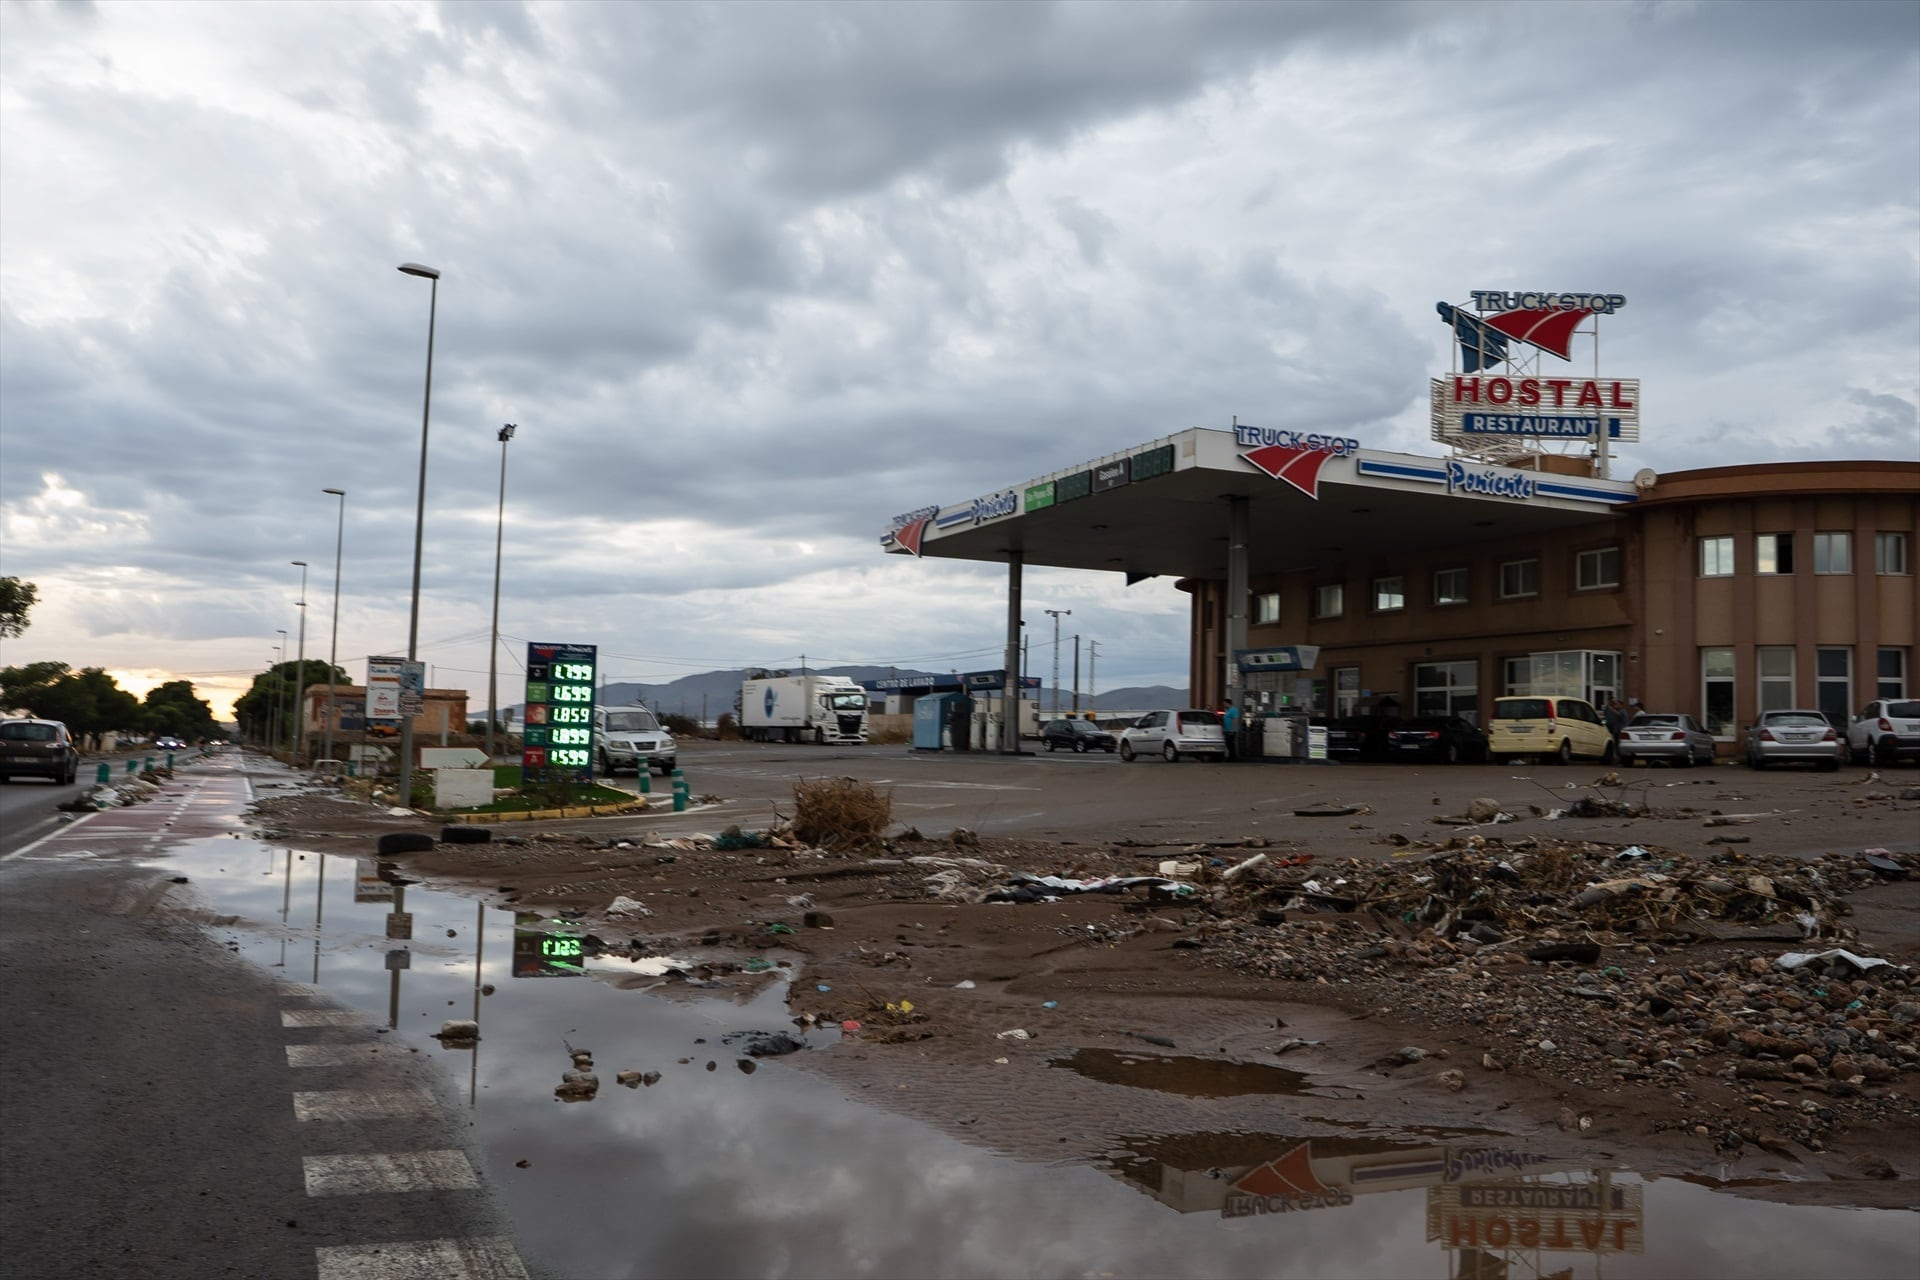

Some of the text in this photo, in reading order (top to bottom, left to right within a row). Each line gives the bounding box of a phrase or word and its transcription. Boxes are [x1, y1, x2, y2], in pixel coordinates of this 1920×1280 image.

[1472, 291, 1626, 314] TRUCK STOP
[1454, 376, 1633, 409] HOSTAL
[1472, 415, 1611, 434] RESTAURANT
[1237, 425, 1360, 456] TRUCK STOP
[1451, 461, 1532, 498] Poniente
[876, 676, 935, 689] CENTRO DE LAVADO
